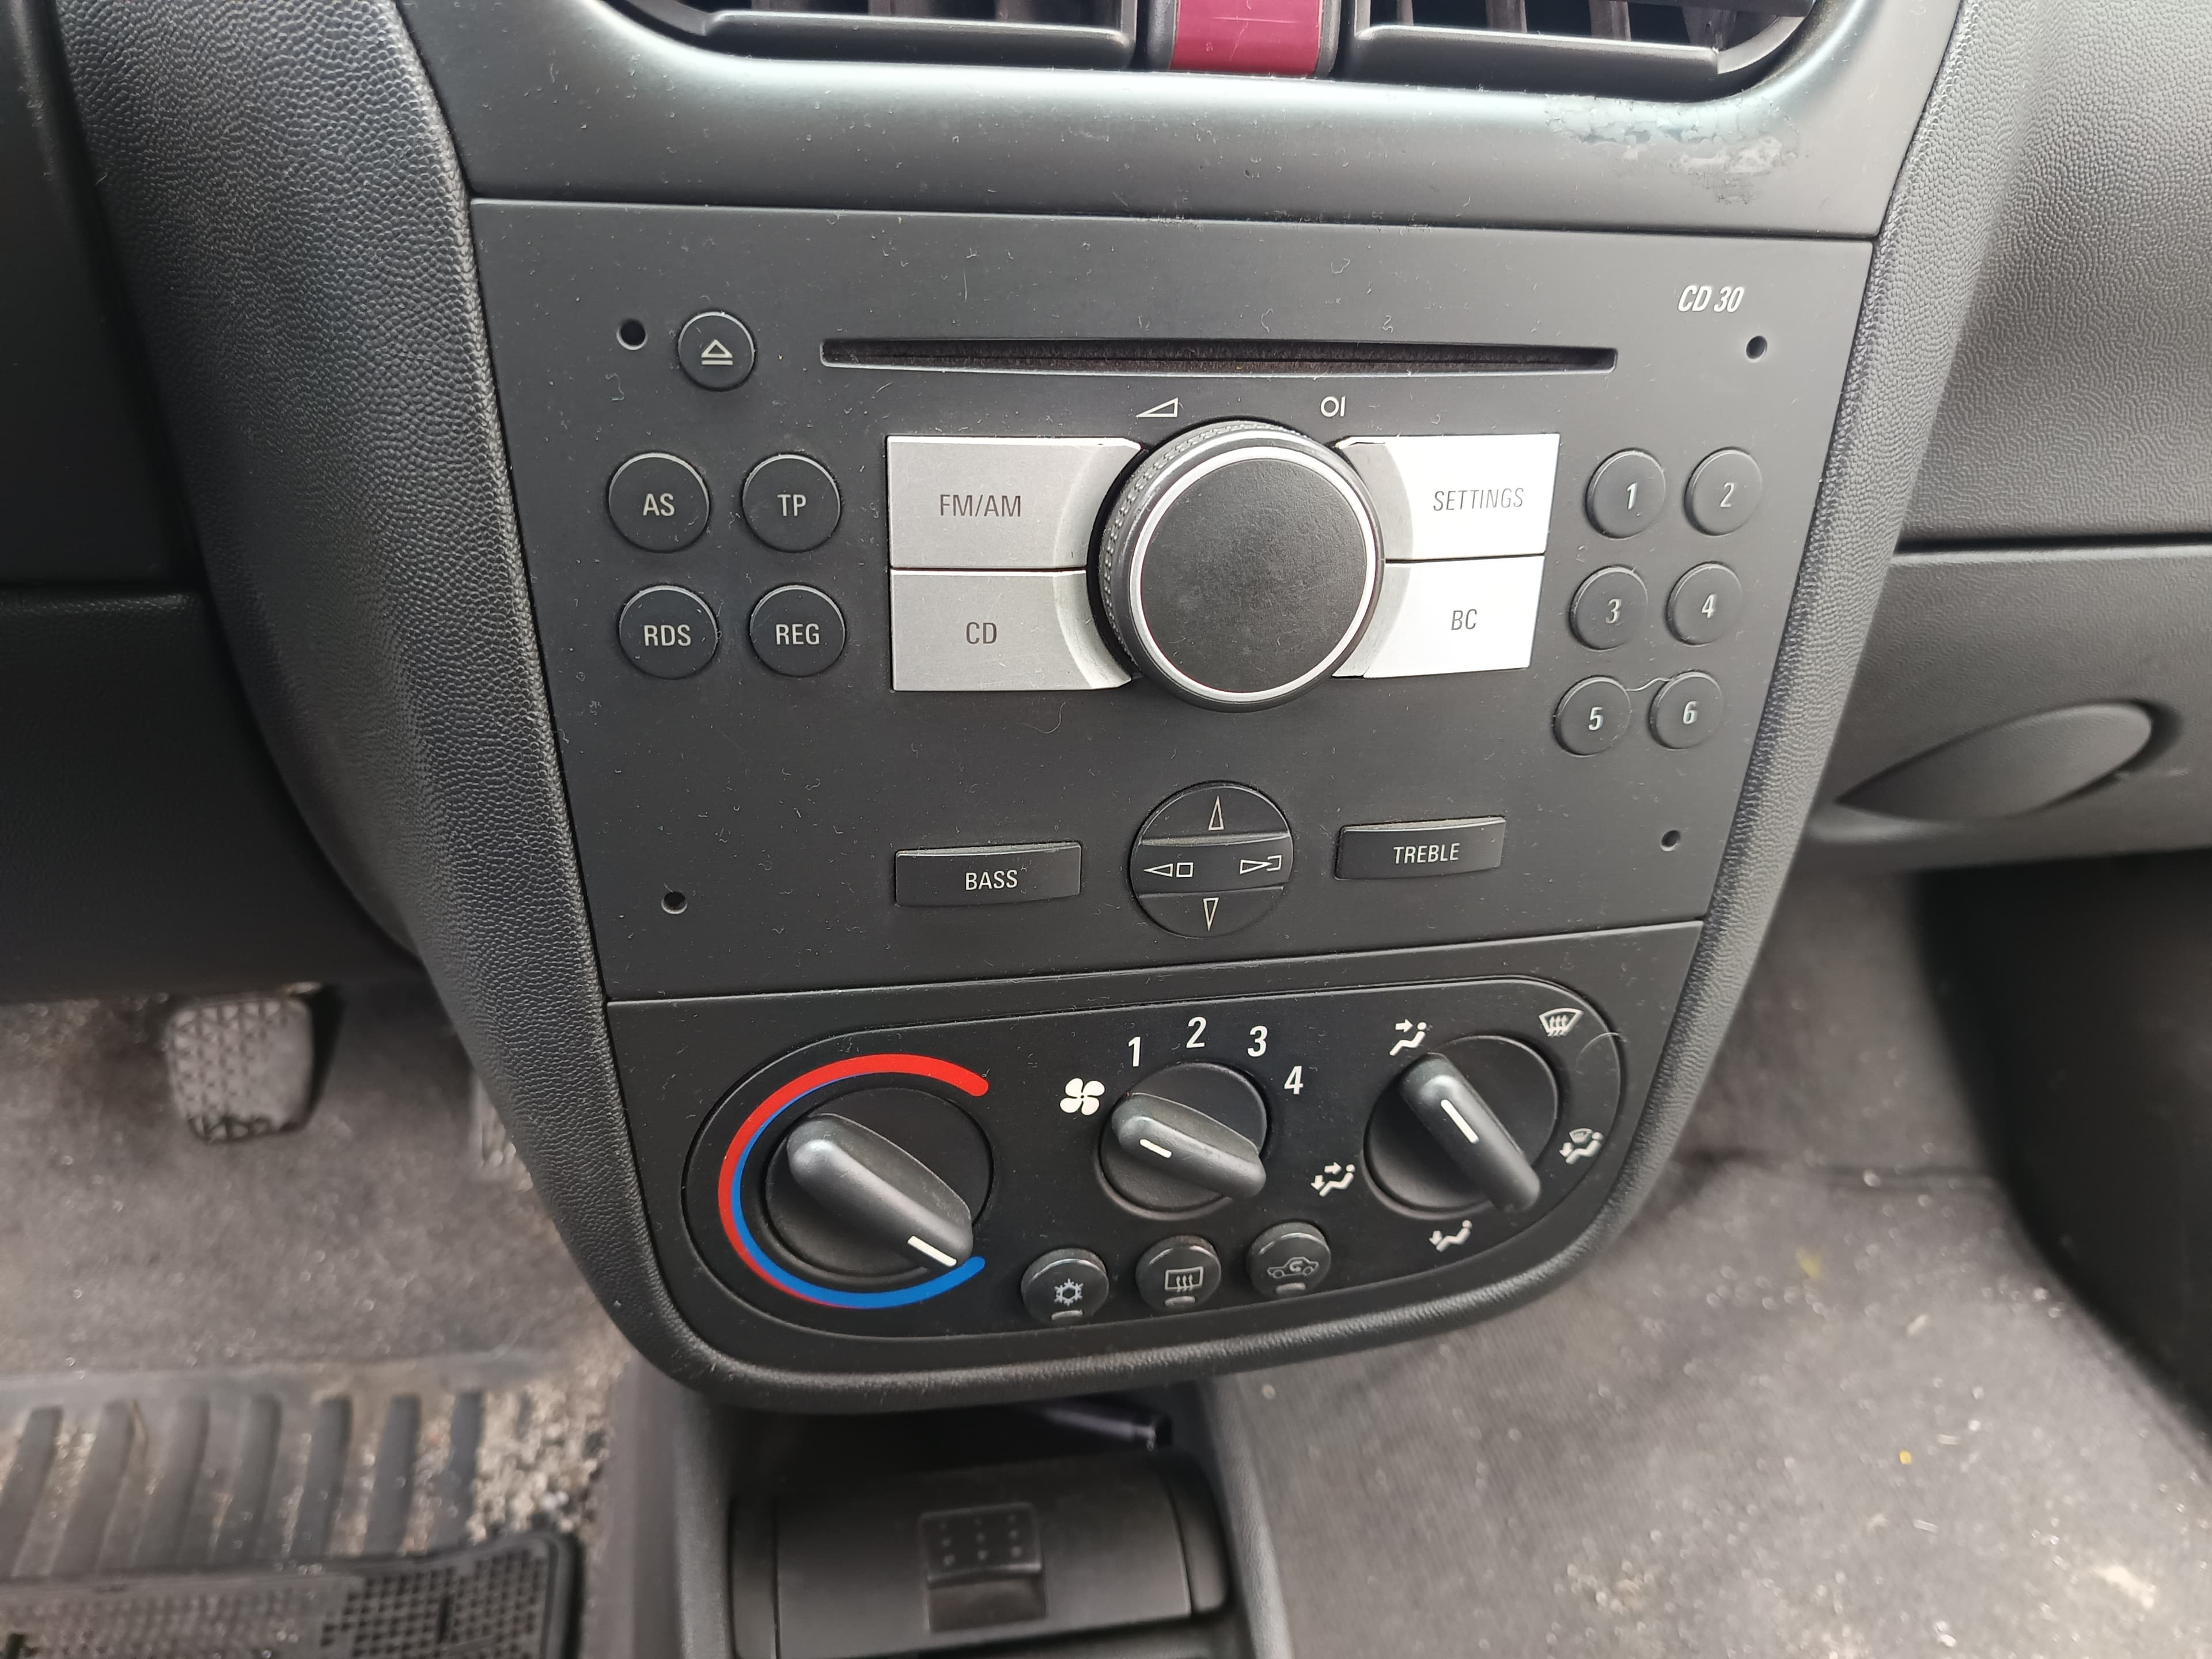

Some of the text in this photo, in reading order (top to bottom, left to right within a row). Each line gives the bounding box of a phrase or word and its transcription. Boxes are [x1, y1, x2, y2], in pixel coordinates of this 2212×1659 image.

[1677, 285, 1744, 313] CD 30
[642, 493, 675, 517] AS
[777, 494, 807, 517] TP
[939, 494, 1022, 518] FM/AM
[1432, 487, 1525, 512] SETTINGS
[1626, 482, 1639, 510] 1
[1719, 482, 1736, 509] 2
[1605, 598, 1622, 624] 3
[1701, 593, 1717, 619] 4
[1450, 608, 1478, 631] BC
[643, 623, 692, 647] RDS
[775, 623, 820, 646] REG
[965, 621, 998, 646] CD
[1588, 706, 1604, 732] 5
[1682, 699, 1698, 725] 6
[1392, 842, 1460, 865] TREBLE
[964, 868, 1019, 891] BASS
[1185, 1016, 1206, 1048] 2
[1246, 1025, 1268, 1057] 3
[1127, 1036, 1142, 1067] 1
[1283, 1065, 1304, 1094] 4
